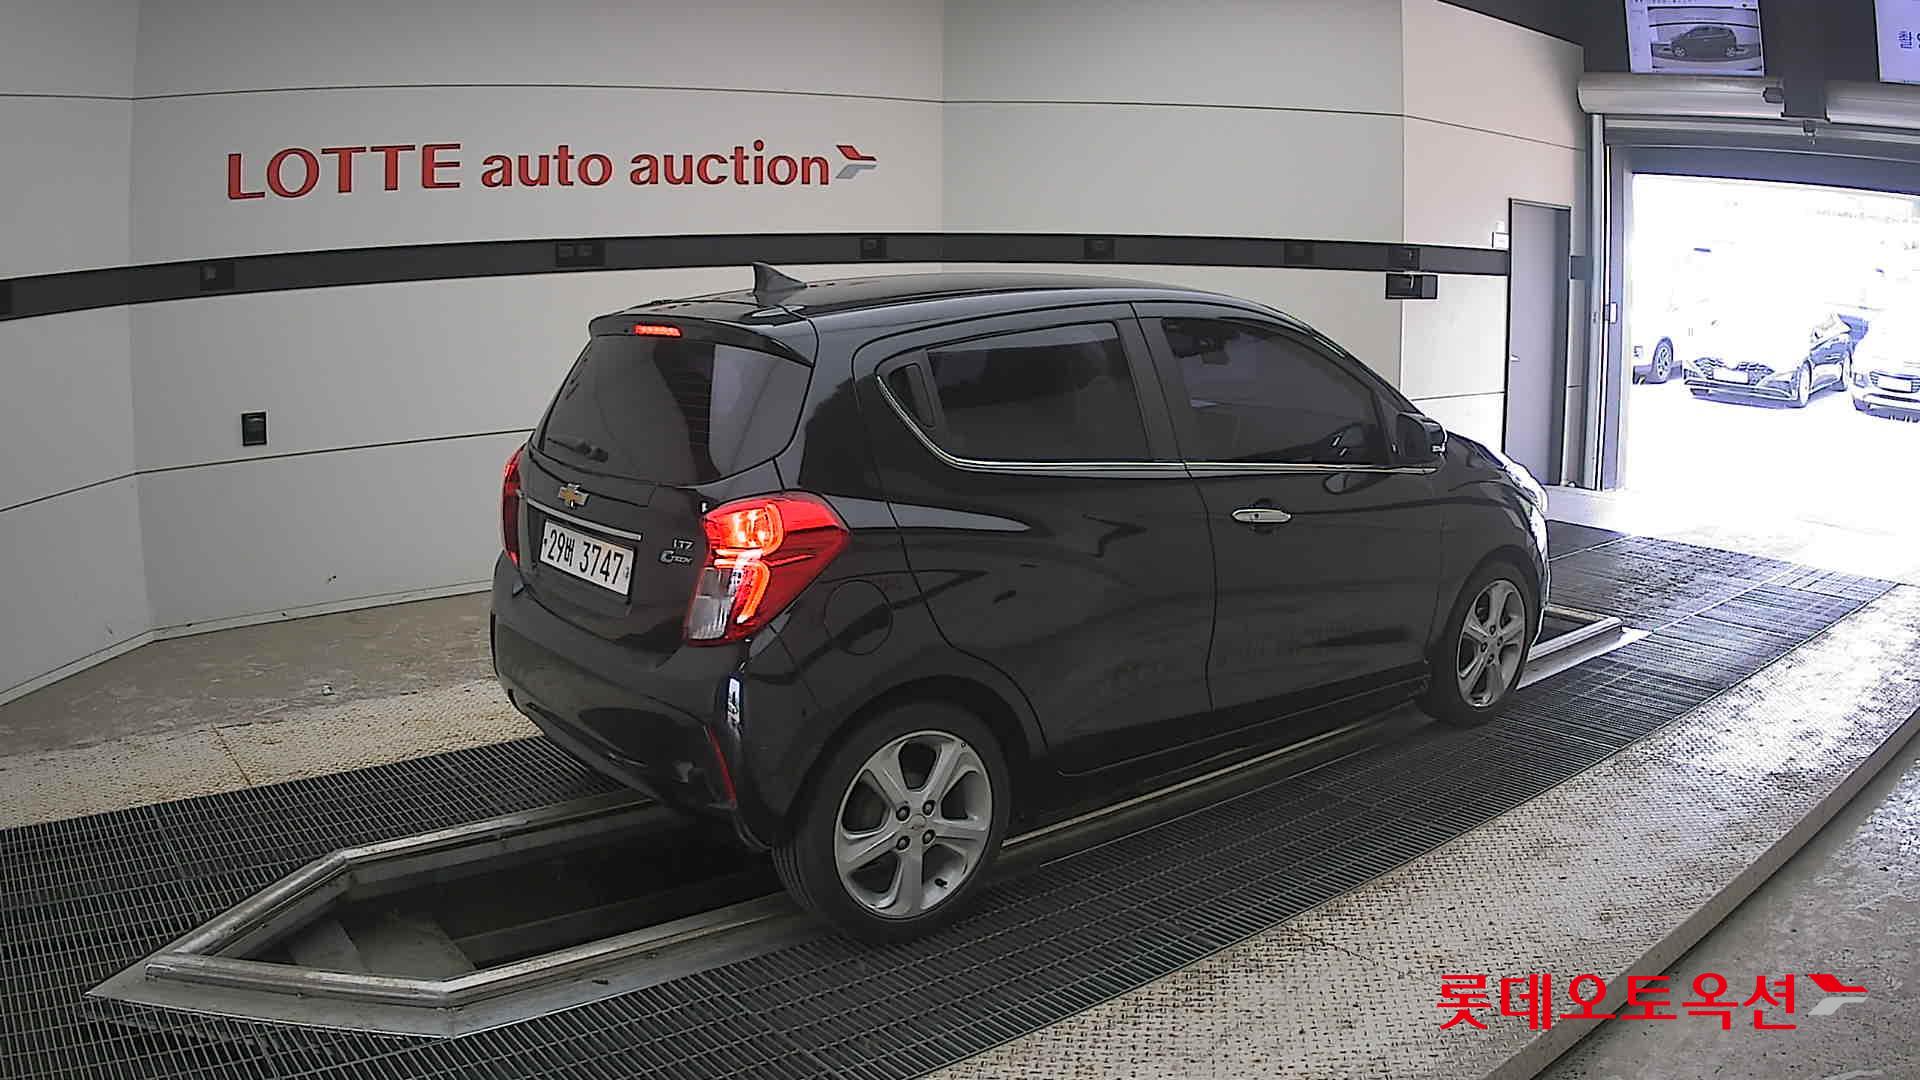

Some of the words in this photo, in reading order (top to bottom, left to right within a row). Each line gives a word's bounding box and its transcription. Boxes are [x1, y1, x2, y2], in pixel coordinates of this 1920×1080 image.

[228, 144, 461, 199] LOTTE
[480, 145, 613, 187] auto
[629, 140, 830, 186] auction
[547, 528, 576, 567] 29버
[579, 541, 625, 585] 3747
